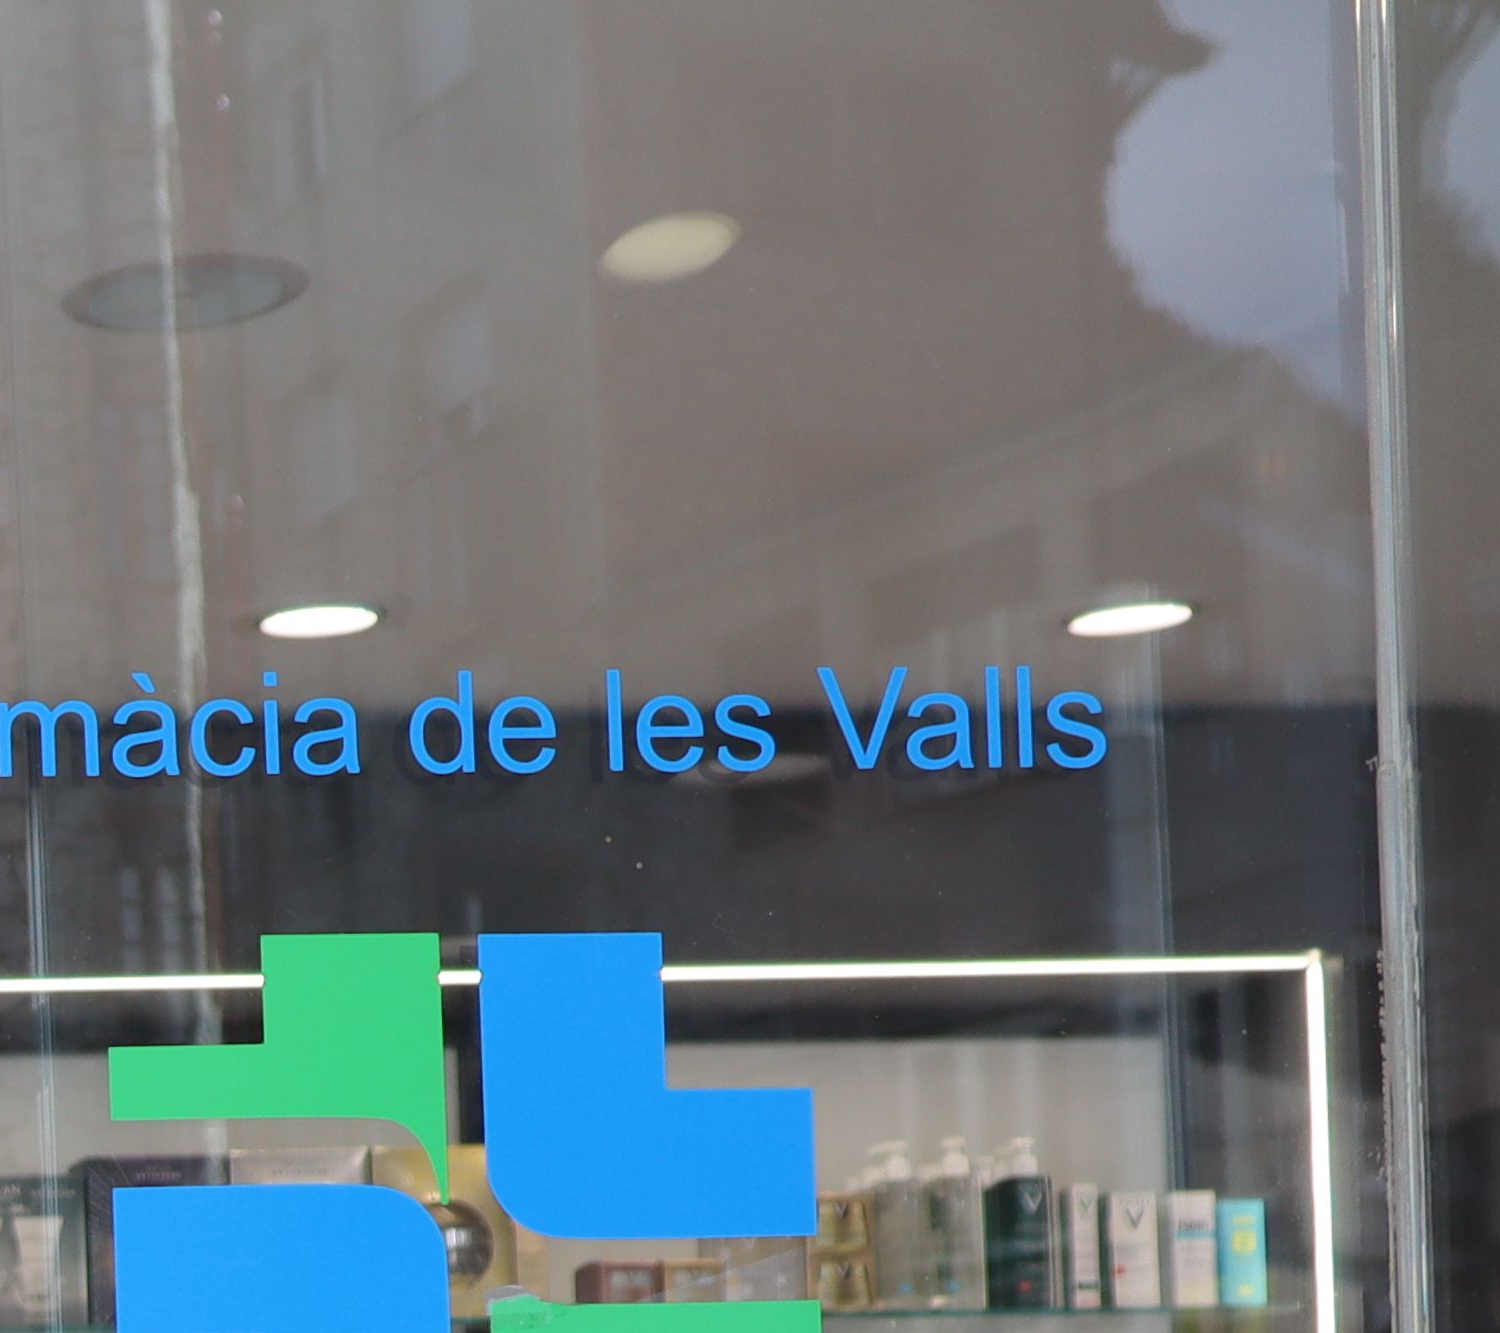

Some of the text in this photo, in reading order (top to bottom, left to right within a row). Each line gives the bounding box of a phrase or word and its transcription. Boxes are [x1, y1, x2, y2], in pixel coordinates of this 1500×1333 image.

[409, 669, 556, 774] de
[605, 669, 775, 773] les
[816, 665, 1108, 770] Valls
